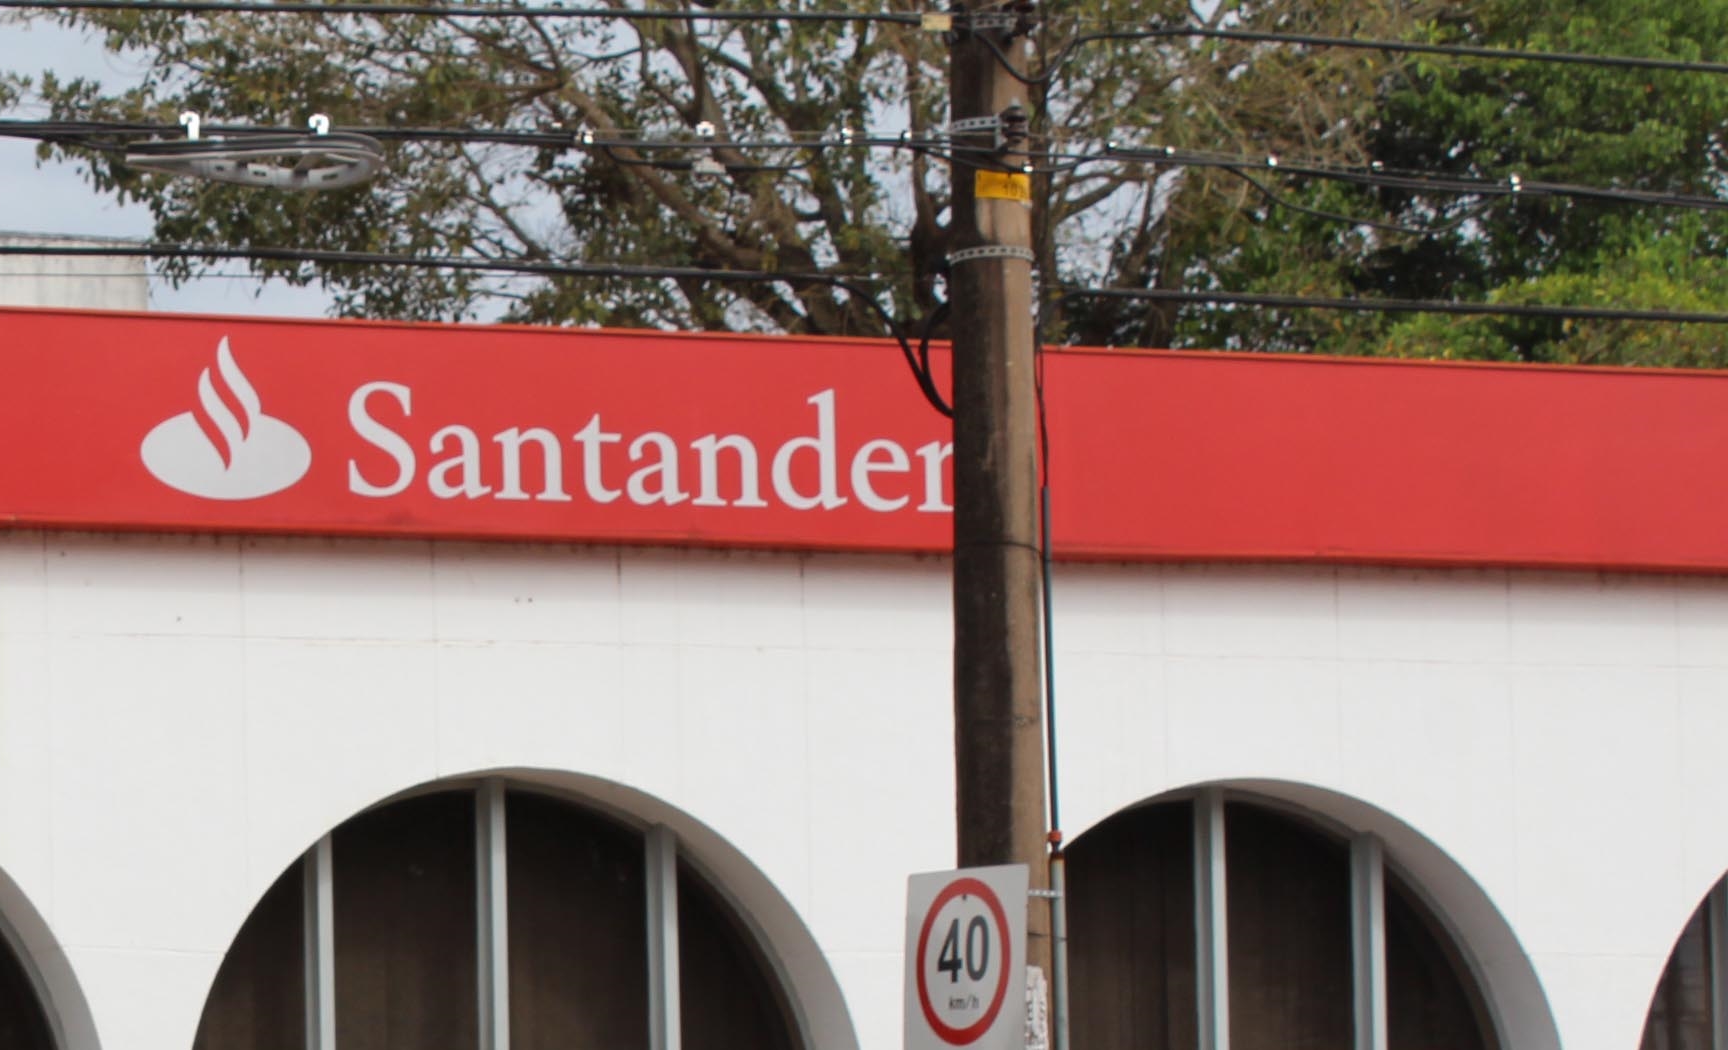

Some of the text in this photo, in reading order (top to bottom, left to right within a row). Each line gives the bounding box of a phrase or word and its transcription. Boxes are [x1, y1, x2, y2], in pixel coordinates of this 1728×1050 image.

[348, 381, 954, 514] Santander
[937, 915, 989, 984] 40
[948, 995, 980, 1011] km/h
